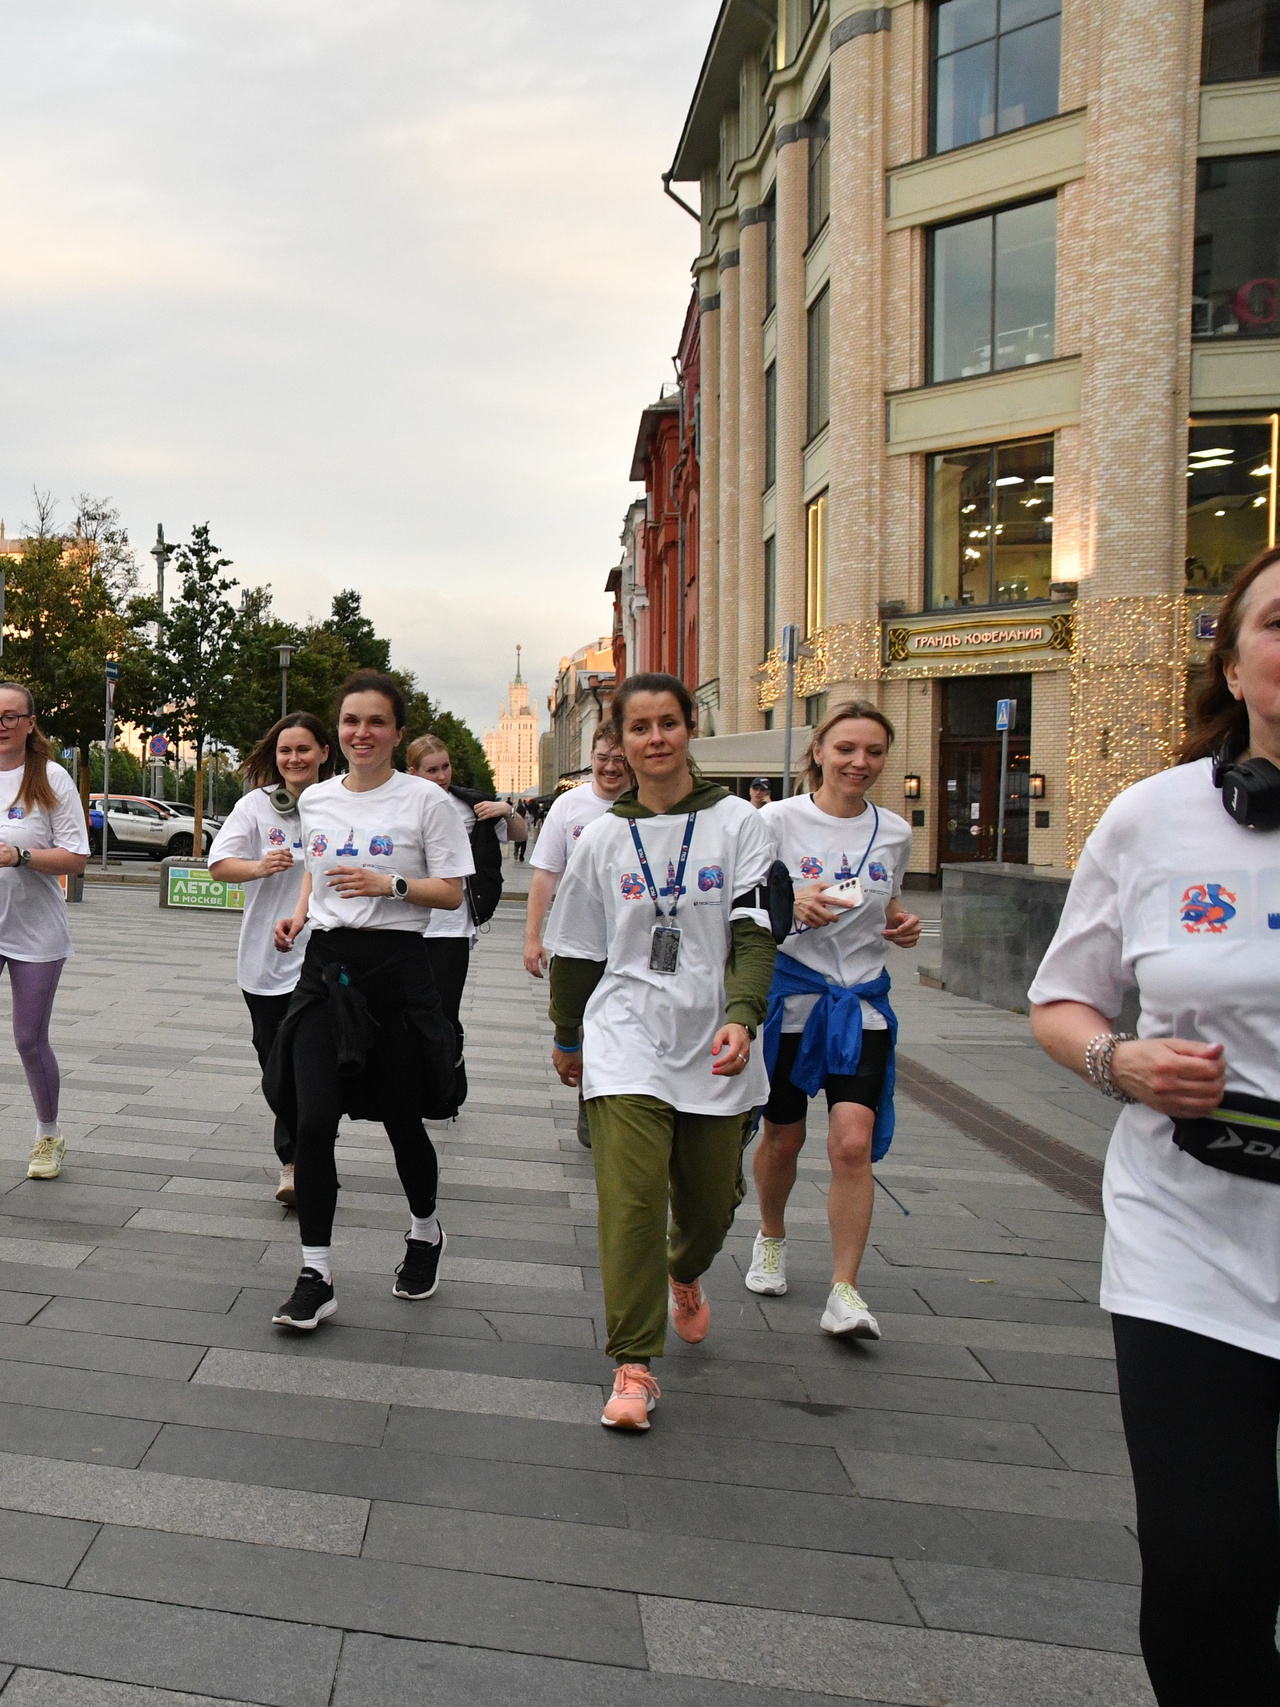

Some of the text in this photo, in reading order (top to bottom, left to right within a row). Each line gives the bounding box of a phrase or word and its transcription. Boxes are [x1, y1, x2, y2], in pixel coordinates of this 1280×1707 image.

[914, 627, 1043, 649] ГРАНДЪ КОФЕМАНИЯ
[173, 880, 224, 896] ЛЕТО
[182, 896, 223, 905] МОСКВЕ
